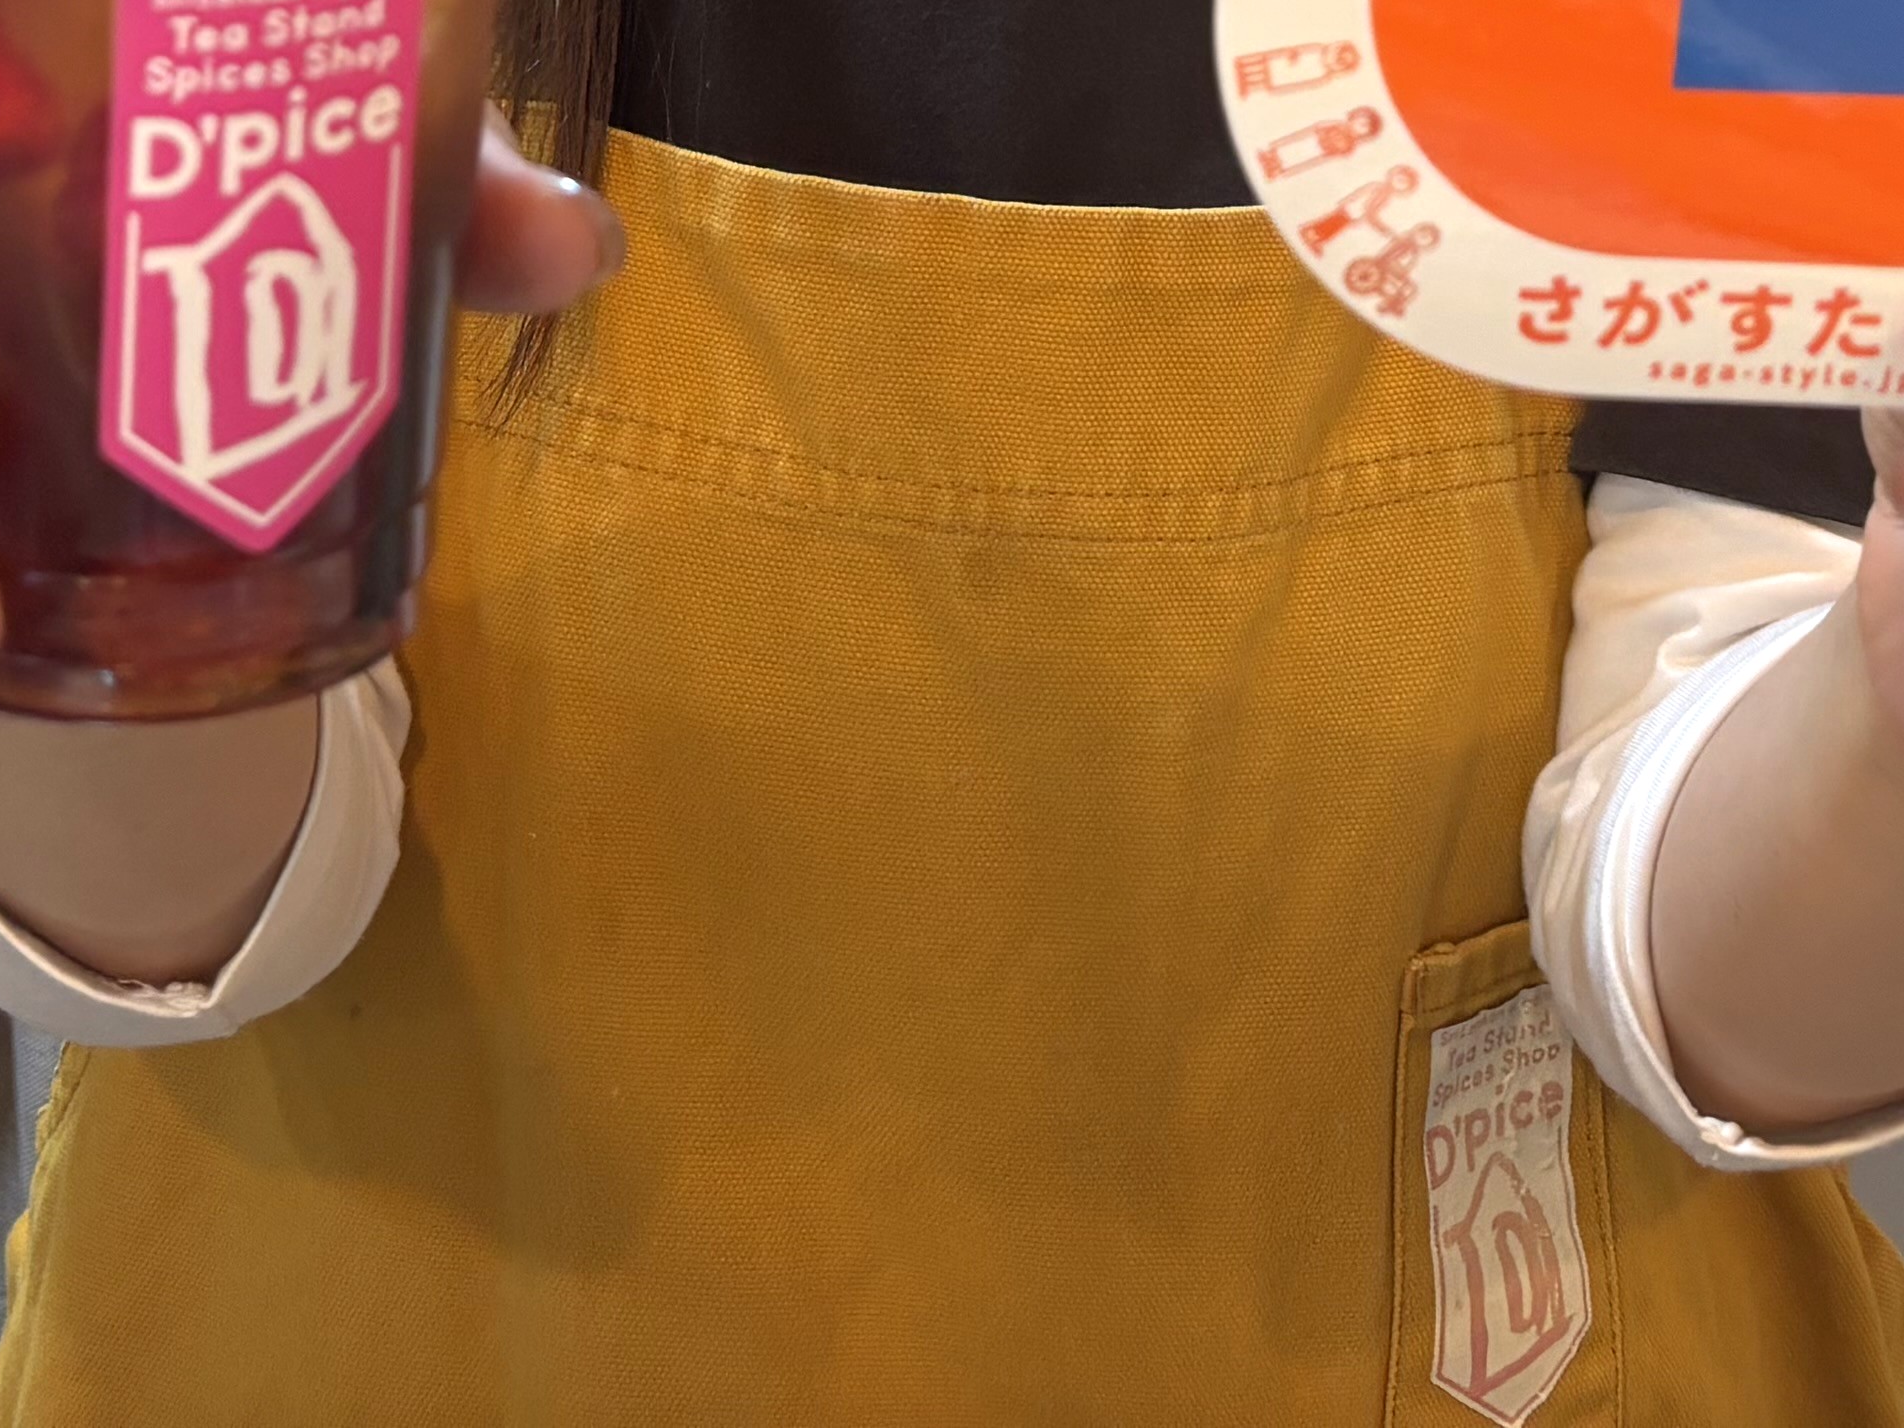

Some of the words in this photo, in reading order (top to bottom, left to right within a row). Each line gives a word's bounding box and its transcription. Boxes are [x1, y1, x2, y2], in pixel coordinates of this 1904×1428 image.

[144, 55, 292, 106] Spices
[303, 34, 401, 82] Shop
[168, 14, 250, 56] Tea
[128, 82, 402, 200] D'pice
[1432, 1063, 1495, 1109] Spices
[1426, 1080, 1564, 1191] D'pice
